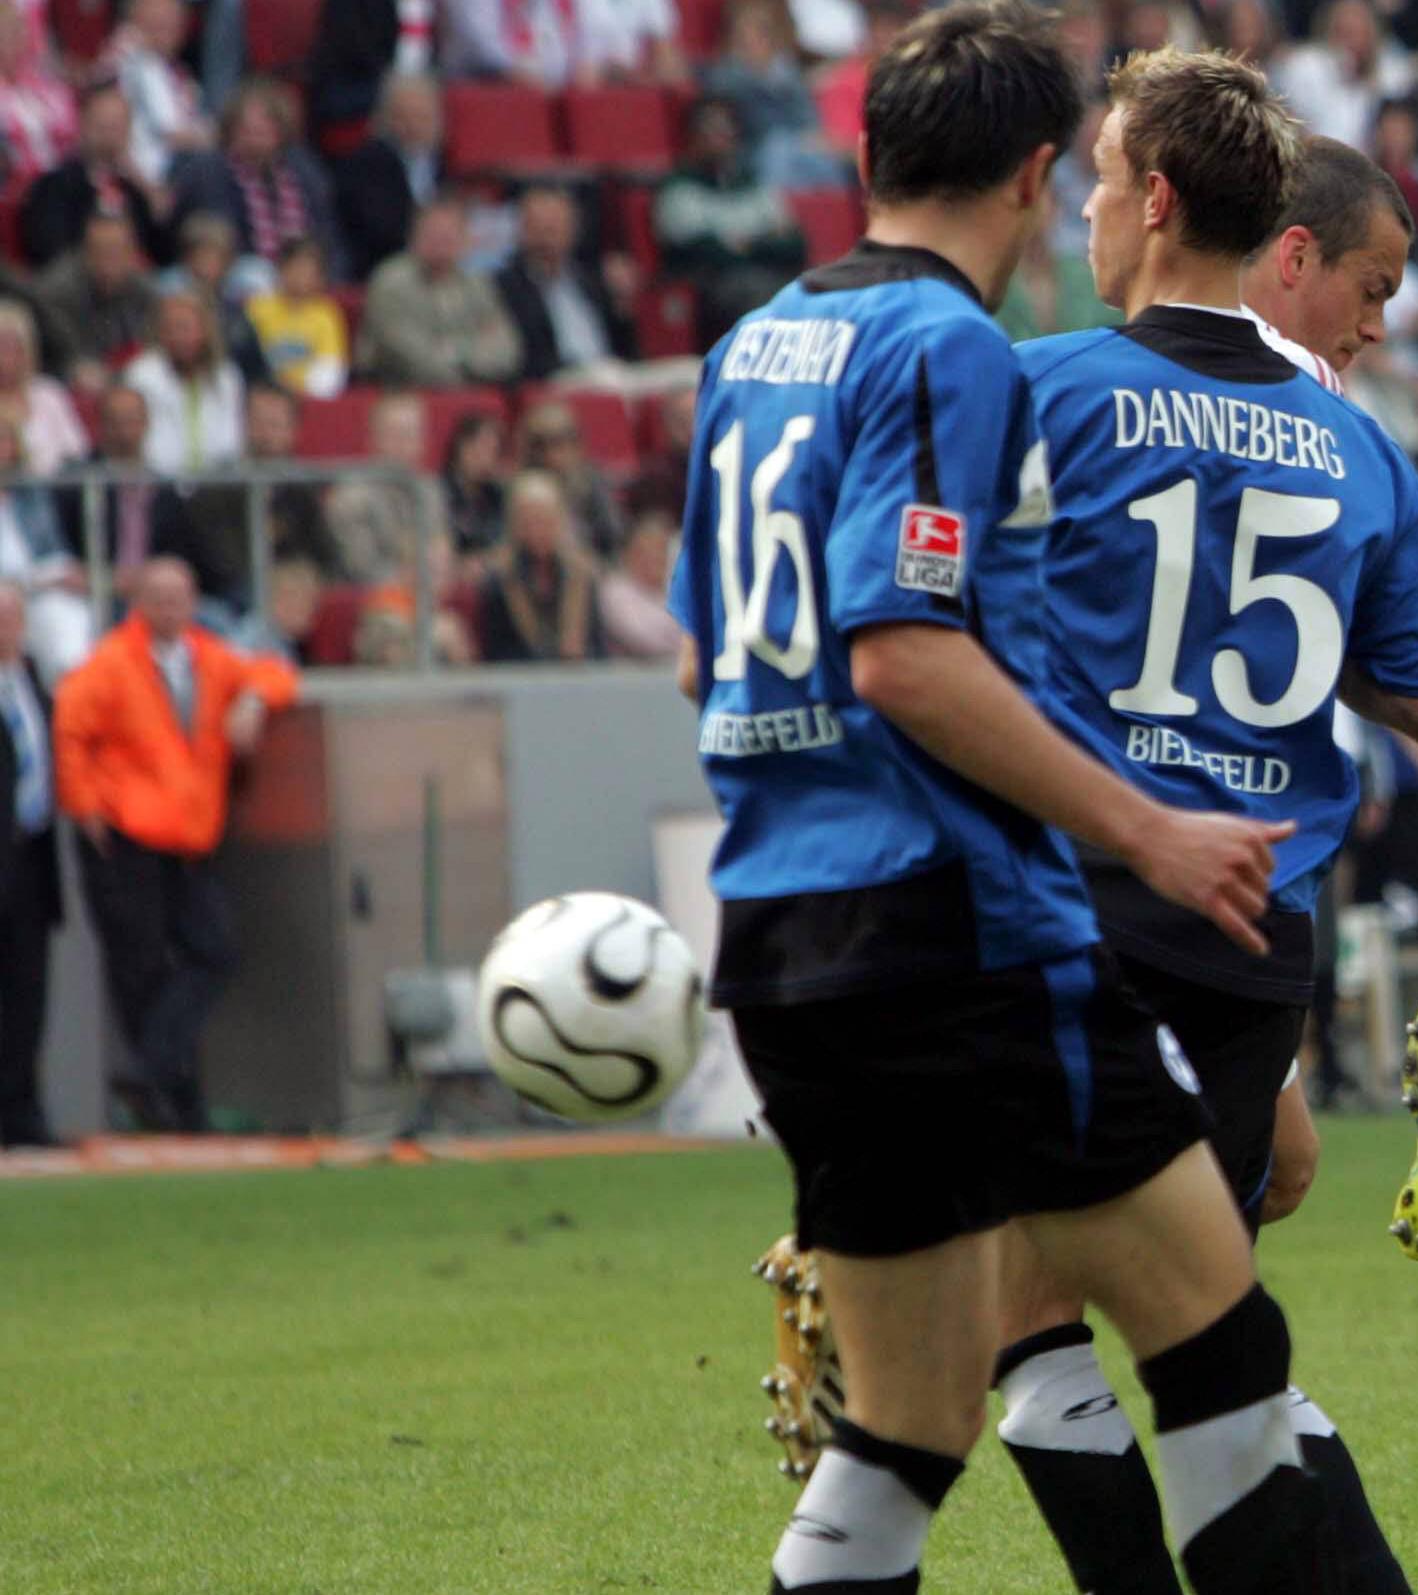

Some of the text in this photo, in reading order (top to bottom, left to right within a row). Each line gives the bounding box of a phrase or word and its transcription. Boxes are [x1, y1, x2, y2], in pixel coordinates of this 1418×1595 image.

[1112, 388, 1345, 480] DANNEBERG
[710, 415, 819, 680] 16
[898, 563, 955, 589] LIGA
[1109, 478, 1342, 728] 15
[1126, 724, 1291, 795] BIELFELD
